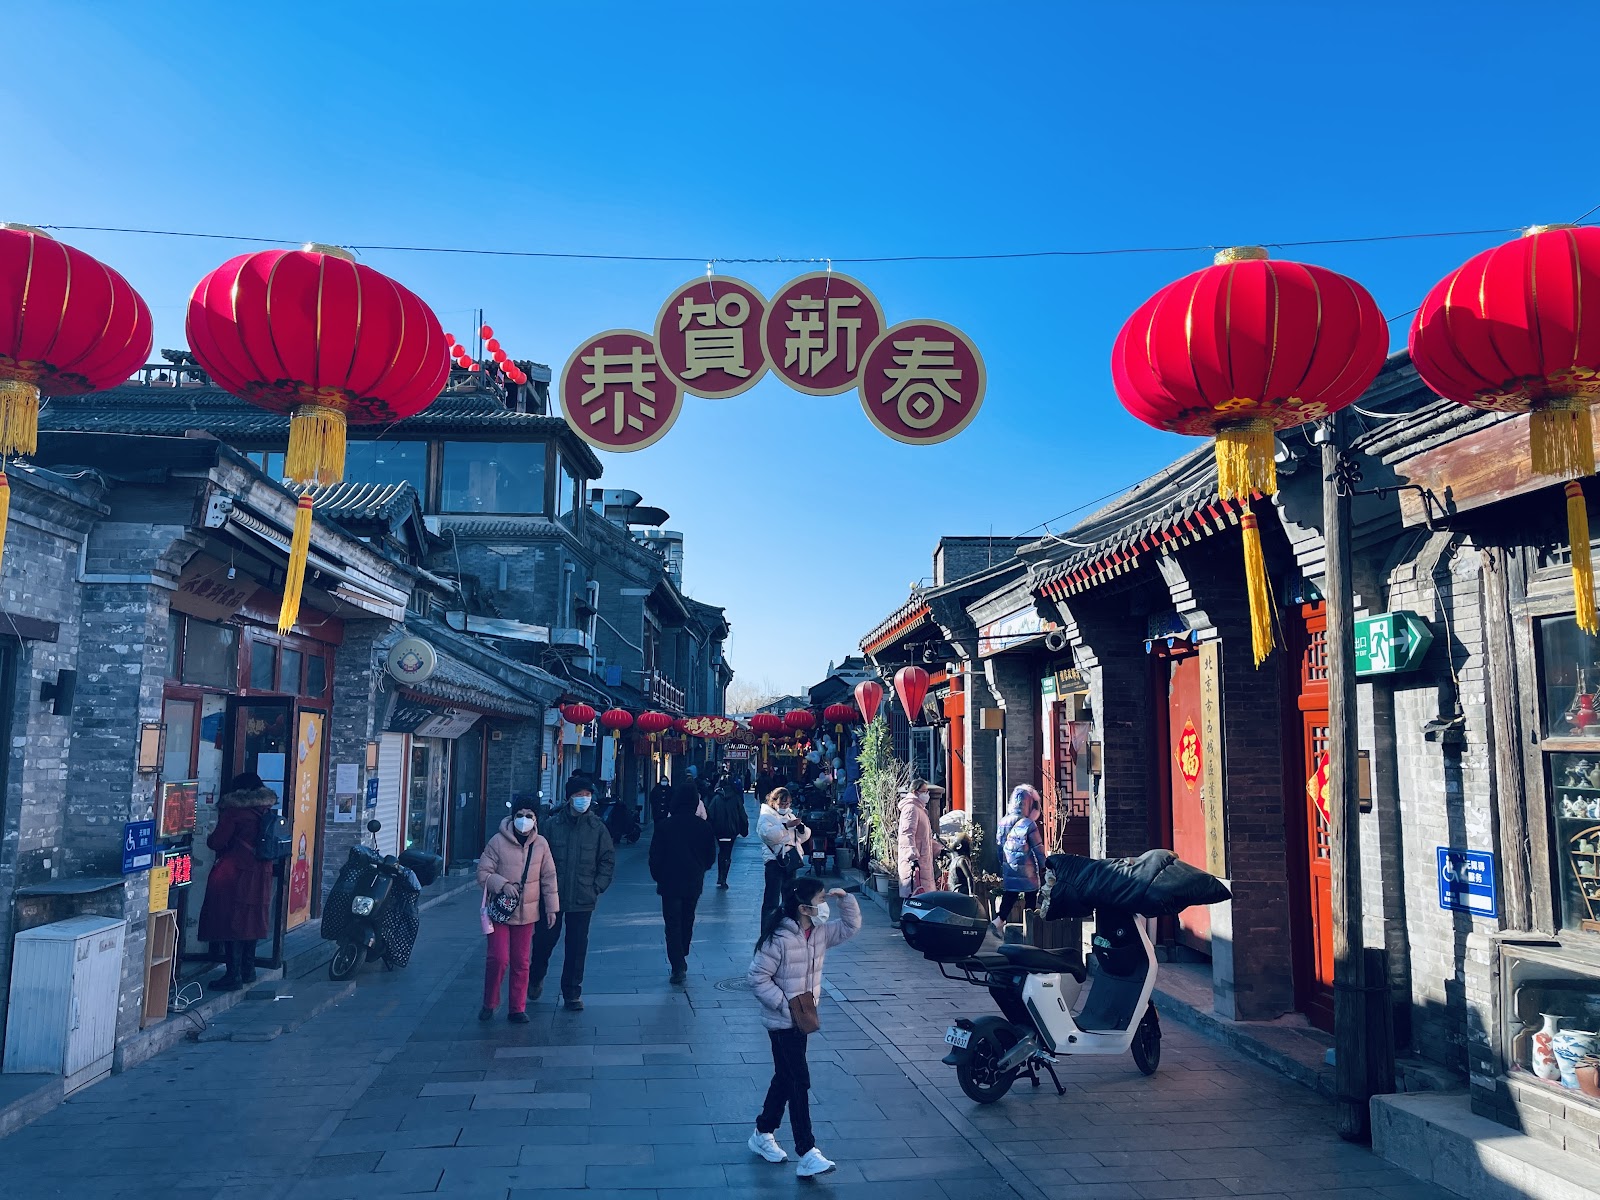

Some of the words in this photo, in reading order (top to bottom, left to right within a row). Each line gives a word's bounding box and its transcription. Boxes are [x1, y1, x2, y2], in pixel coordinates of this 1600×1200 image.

[581, 292, 963, 435] 恭賀新春
[1181, 733, 1200, 777] 福
